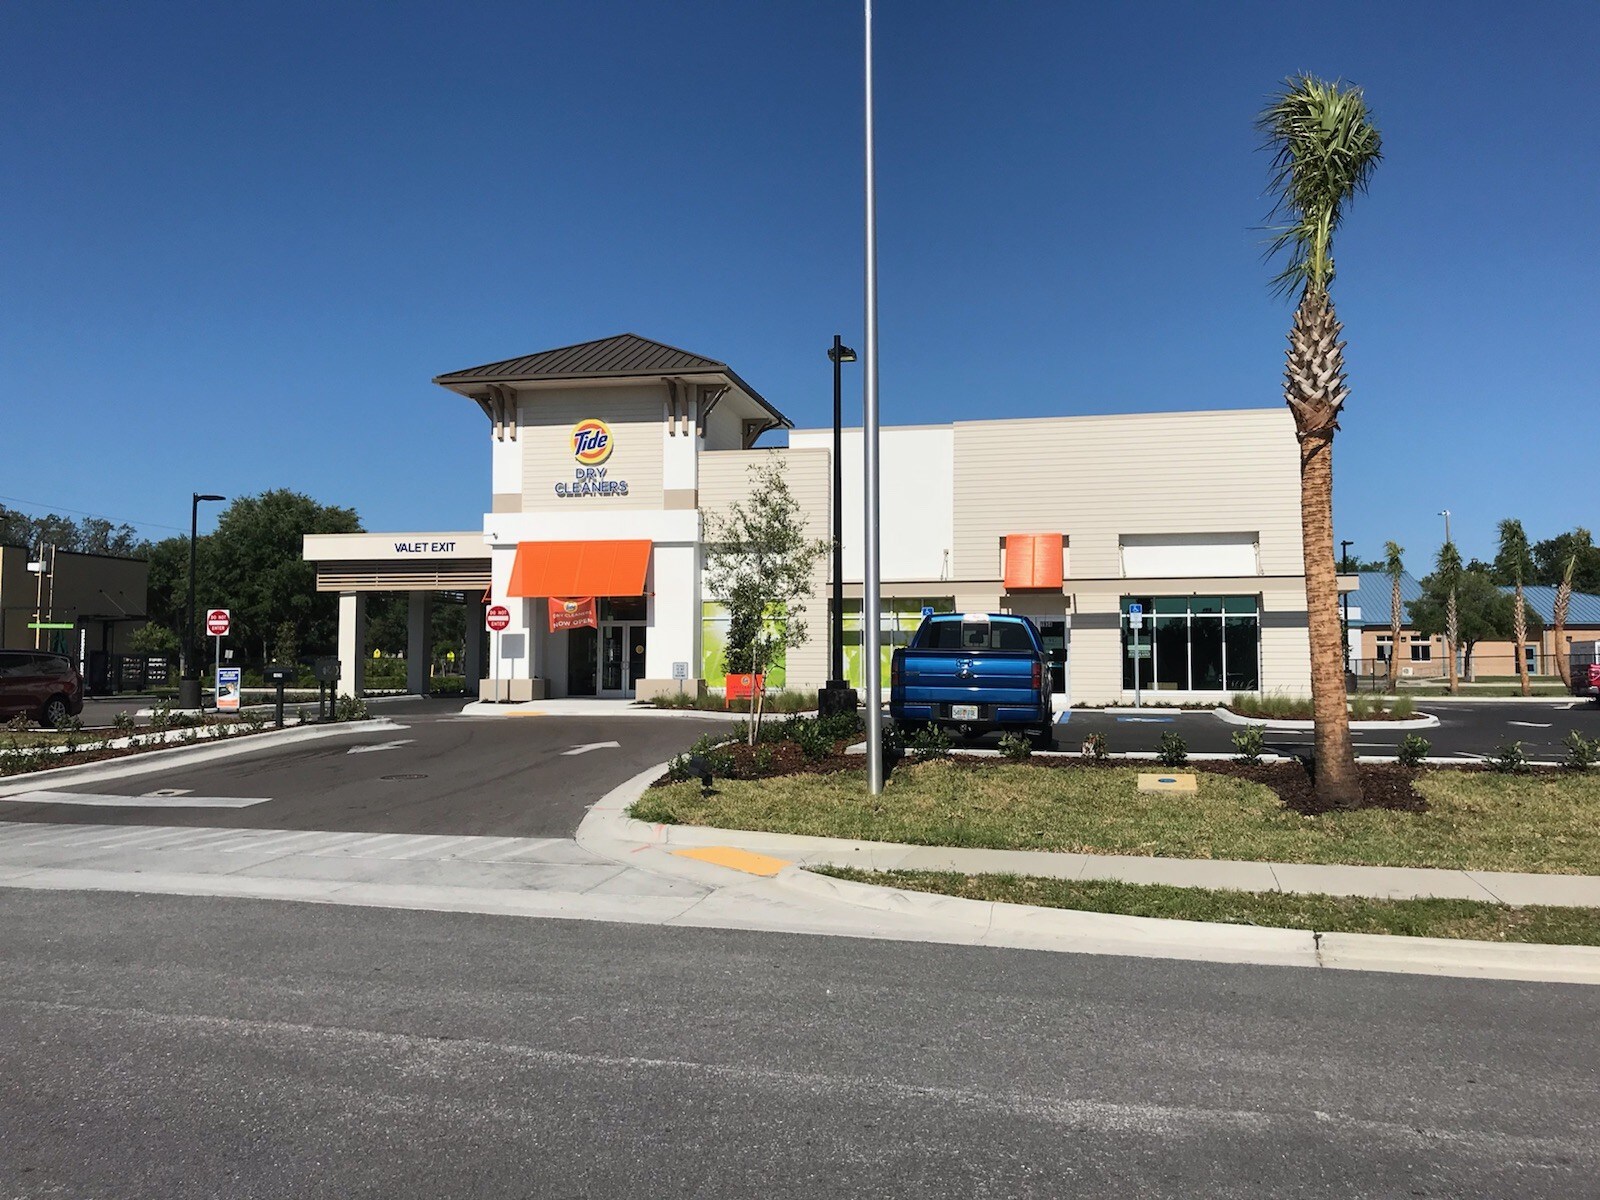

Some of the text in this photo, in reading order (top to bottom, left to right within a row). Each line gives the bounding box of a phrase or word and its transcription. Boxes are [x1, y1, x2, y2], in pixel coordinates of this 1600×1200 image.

[574, 429, 608, 456] Tide
[575, 468, 606, 479] DRY
[554, 480, 628, 494] CLEANERS
[394, 542, 456, 553] VALET EXIT
[553, 618, 594, 628] NOW OPEN
